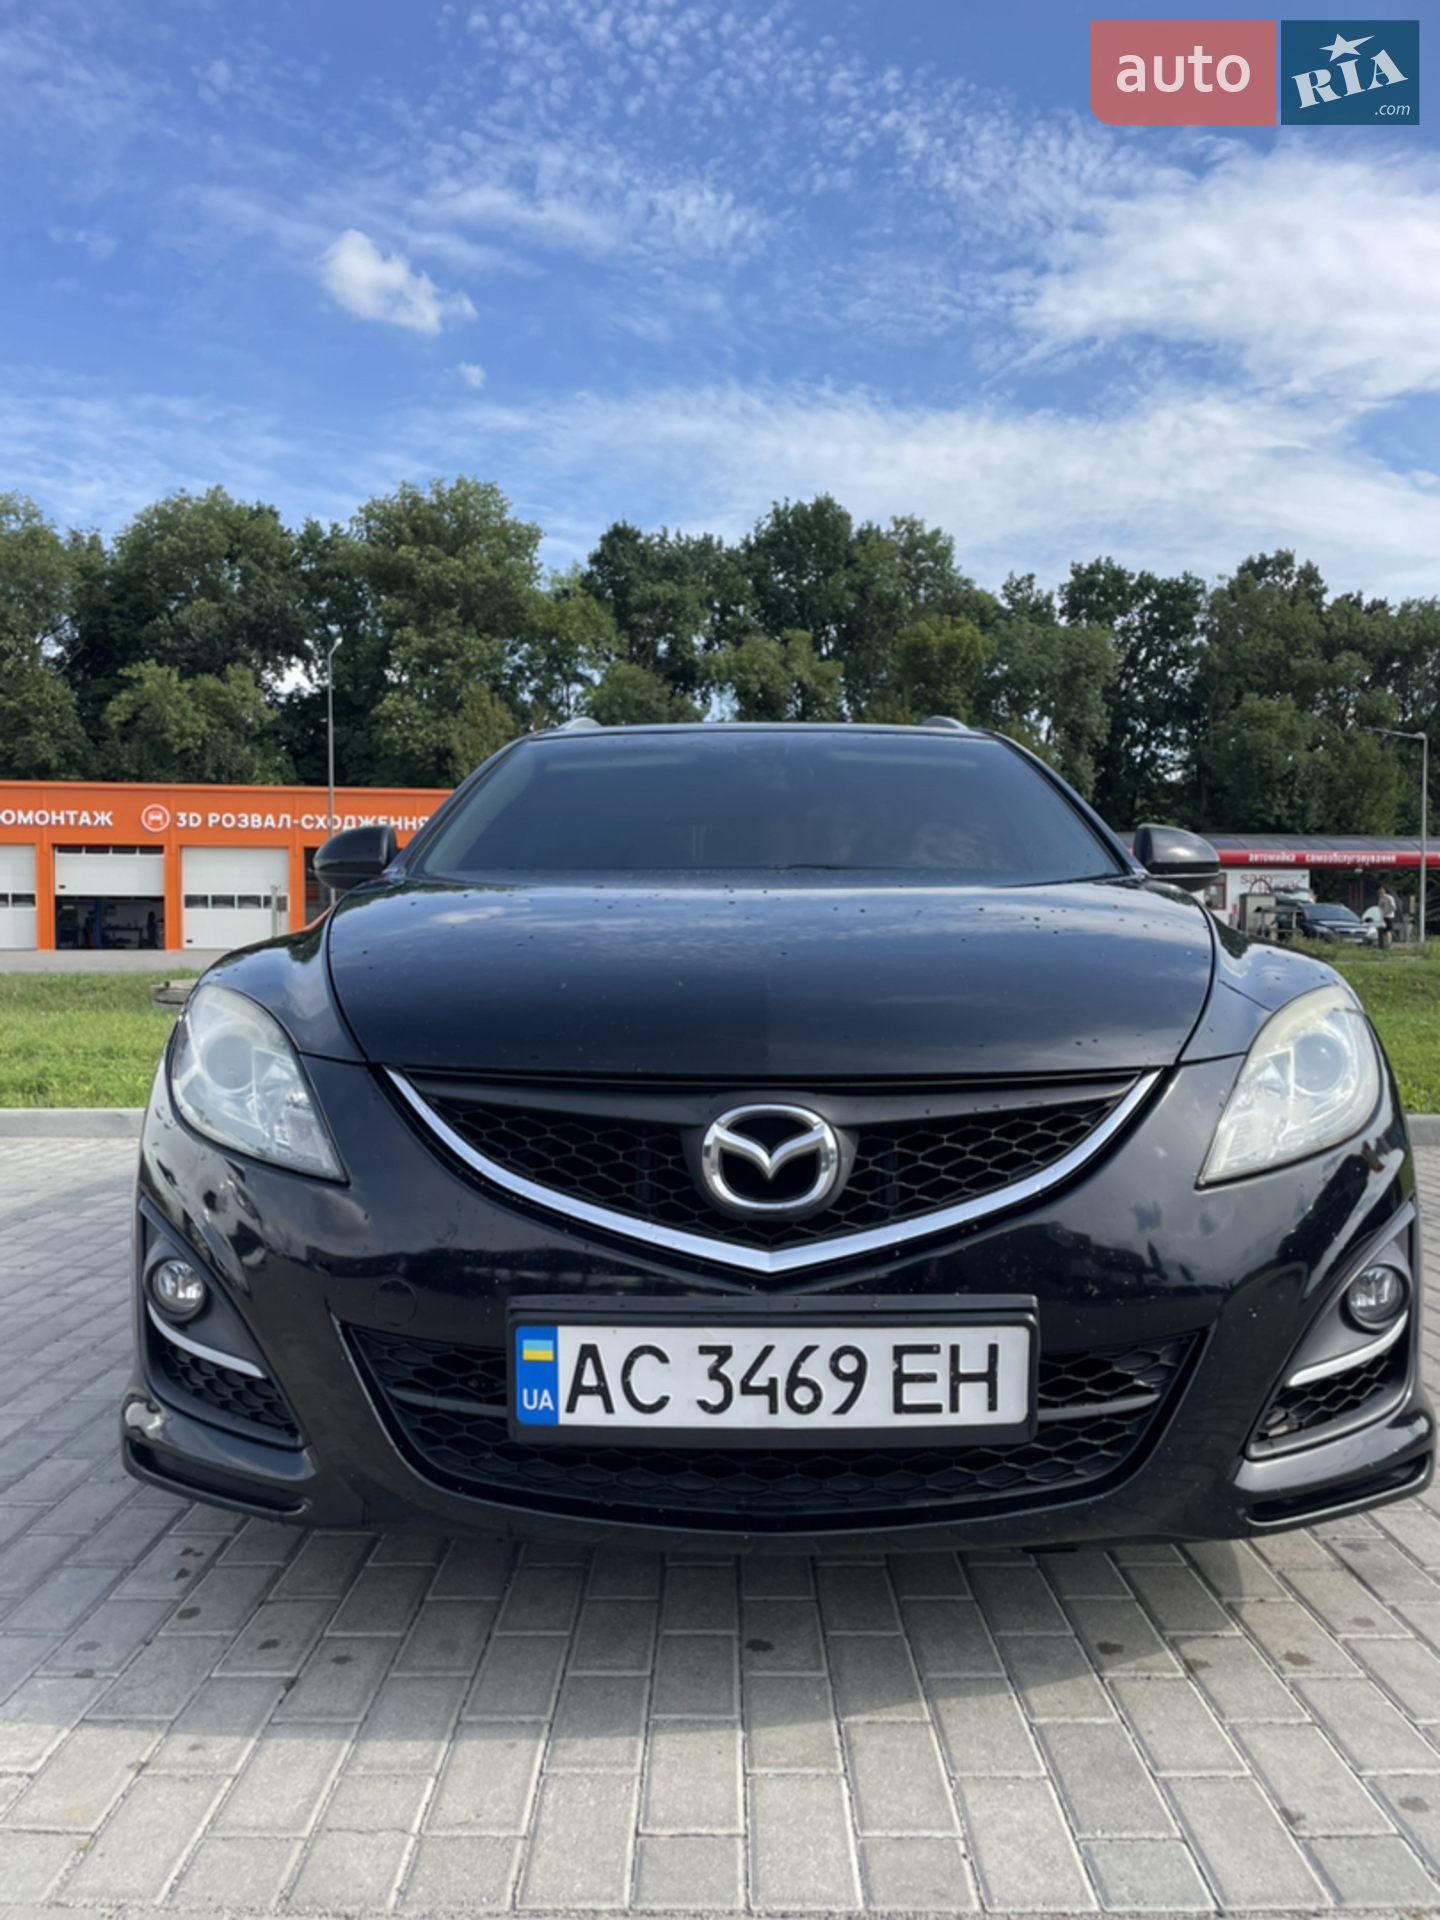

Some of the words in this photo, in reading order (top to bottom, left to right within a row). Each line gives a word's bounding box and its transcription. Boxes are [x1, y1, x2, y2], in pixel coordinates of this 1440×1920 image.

[176, 812, 202, 828] 3D
[565, 1343, 671, 1414] AC
[695, 1344, 868, 1415] 3469
[892, 1343, 999, 1414] EH
[522, 1389, 554, 1411] UA
